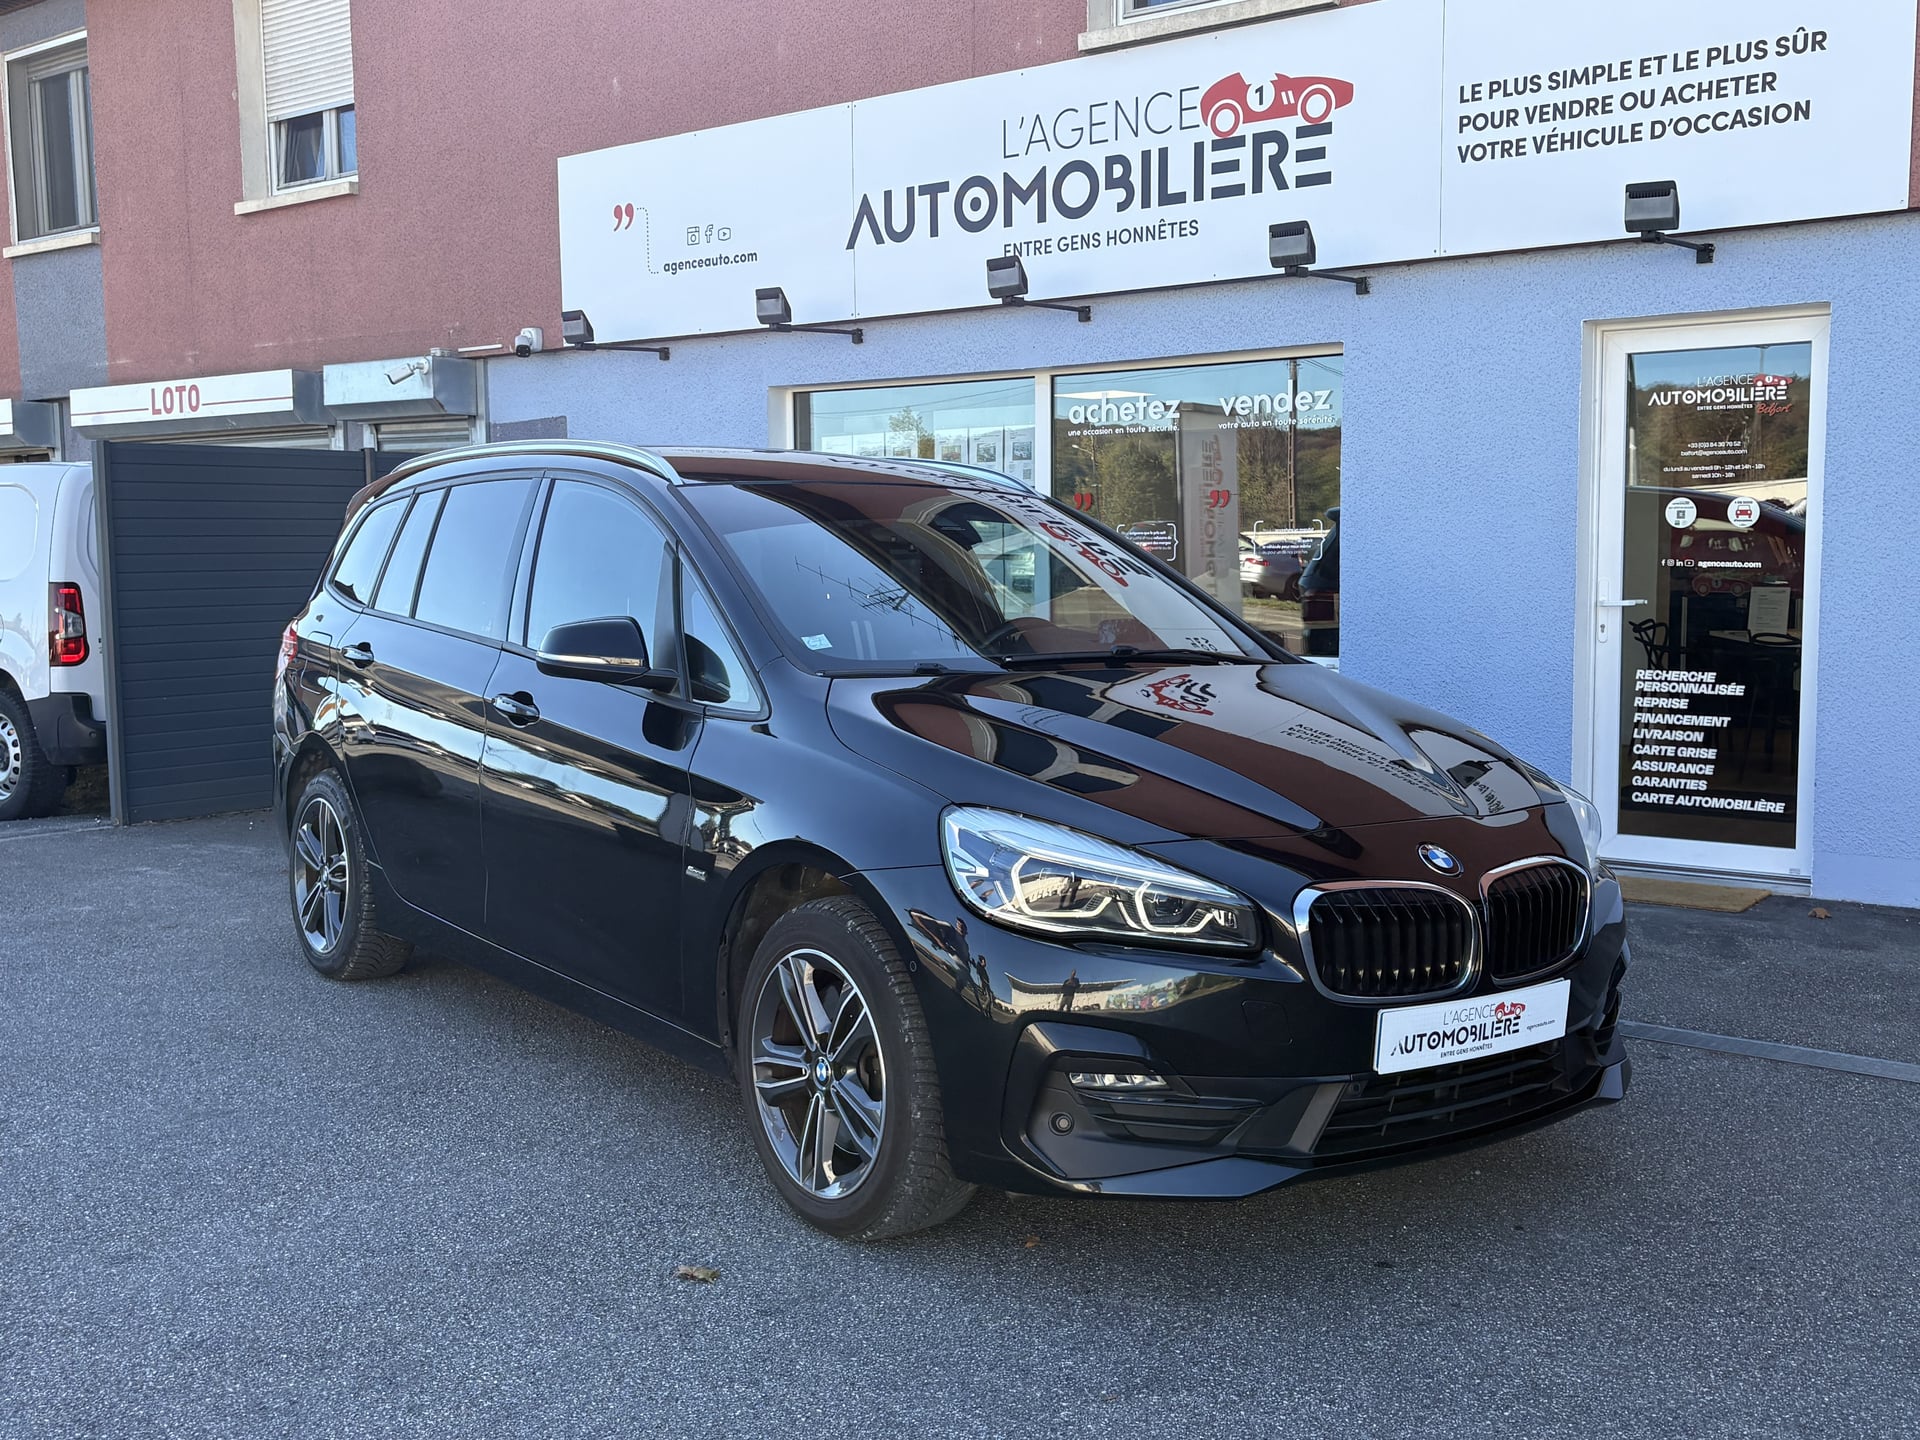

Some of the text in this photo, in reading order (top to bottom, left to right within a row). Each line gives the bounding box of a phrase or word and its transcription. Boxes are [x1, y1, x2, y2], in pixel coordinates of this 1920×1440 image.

[1460, 27, 1827, 103] LE PLUS SIMPLE ET LE PLUS SÛR
[1459, 72, 1777, 133] POUR VENDRE OU ACHETER
[1458, 138, 1527, 163] VOTRE
[1532, 128, 1643, 154] VÉHICULE
[1003, 218, 1199, 258] ENTRE GENS HONNÊTES
[663, 250, 758, 275] agenceauto.com
[151, 384, 200, 415] LOTO
[1219, 380, 1332, 416] vendez
[1068, 392, 1181, 424] achetez
[1757, 403, 1792, 415] Belfort
[1241, 420, 1259, 428] auto
[1275, 418, 1297, 426] toute
[1083, 427, 1113, 436] occasion
[1697, 560, 1762, 569] agenceauto.com
[1636, 669, 1716, 682] RECHERCHE
[1635, 682, 1745, 696] PERSONNALISÉE
[1634, 697, 1689, 709] REPRISE
[1633, 713, 1731, 727] FINANCEMENT
[1633, 729, 1704, 742] LIVRAISON
[1633, 745, 1717, 759] CARTE GRISE
[1632, 761, 1715, 775] ASSURANCE
[1632, 776, 1708, 790] GARANTIES
[1632, 792, 1785, 813] CARTE AUTOMOBILIÈRE
[1440, 1043, 1493, 1058] ENTRE GENS HONNÊTES
